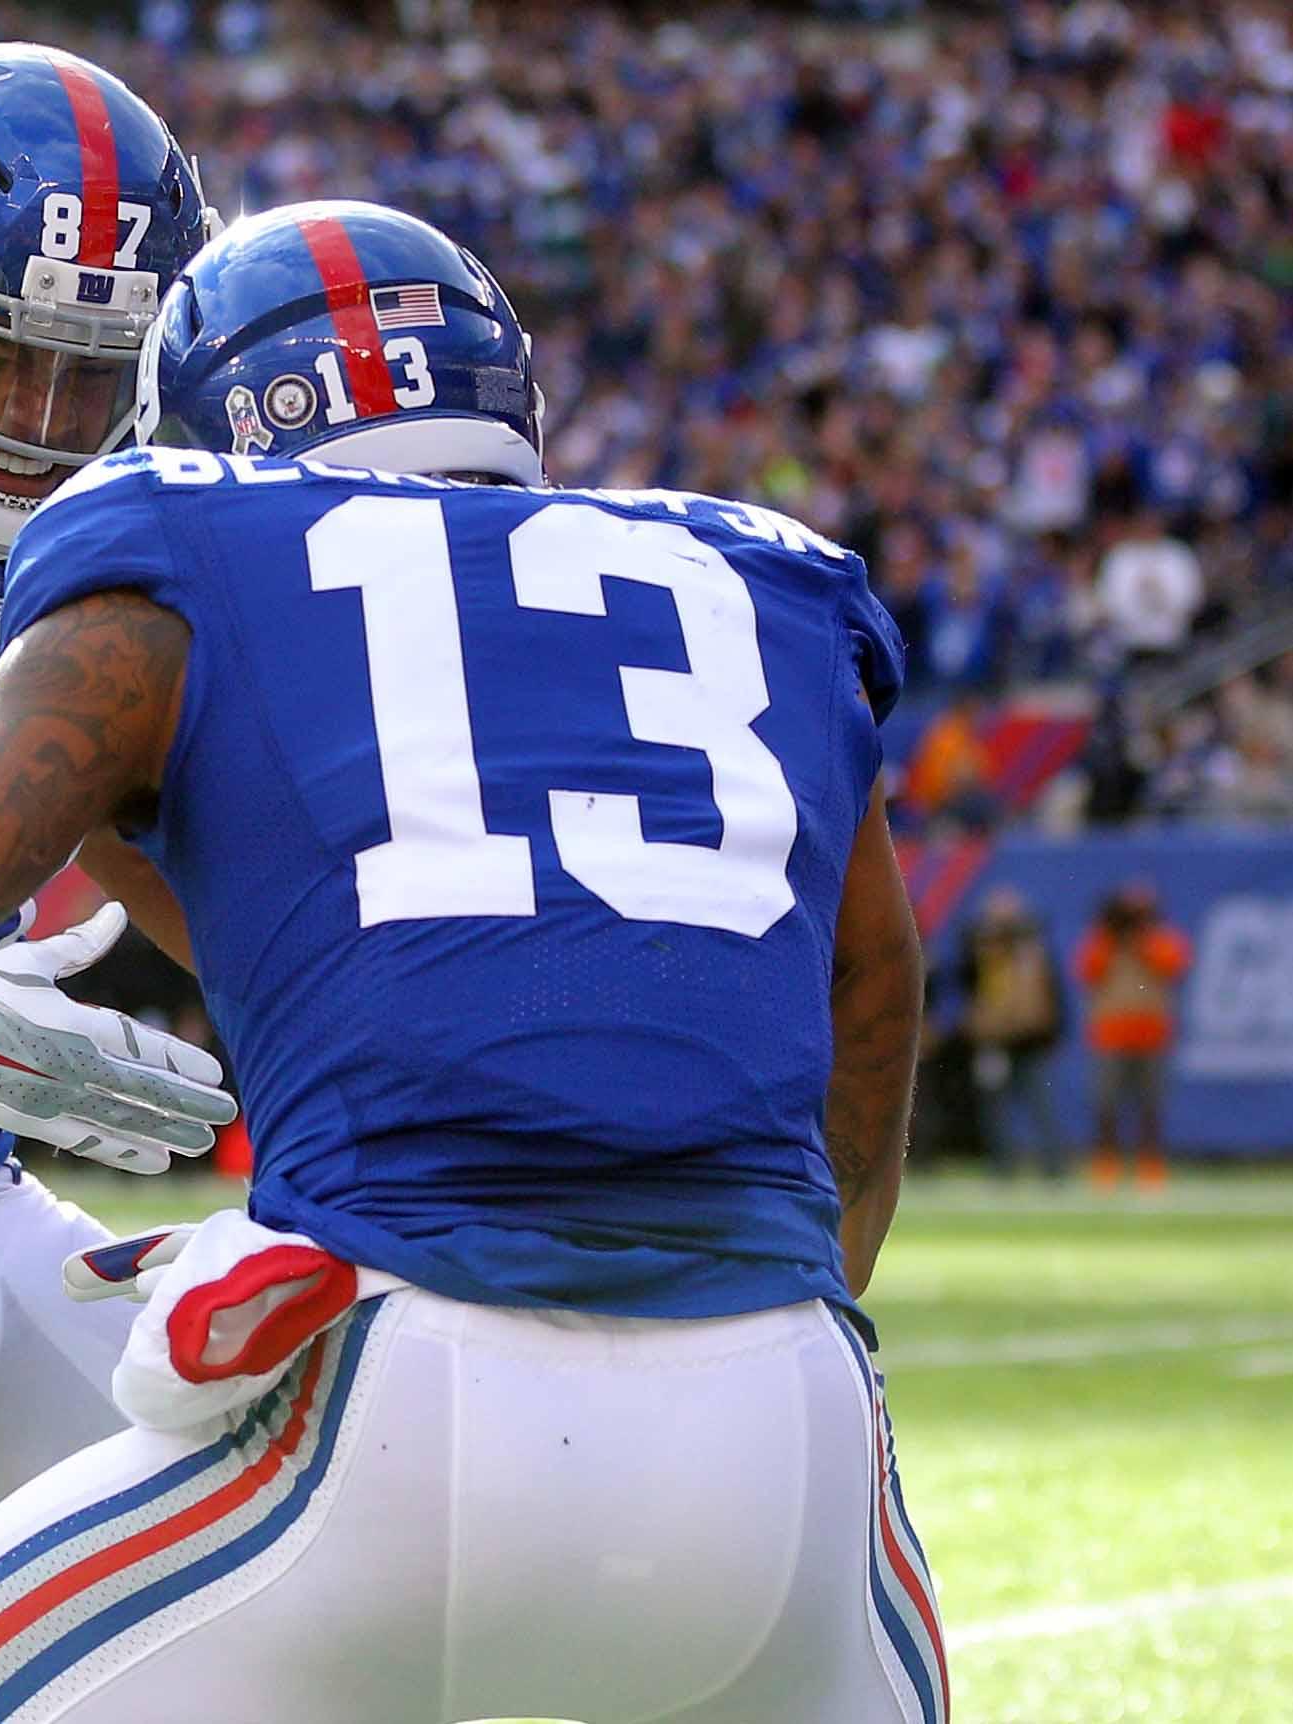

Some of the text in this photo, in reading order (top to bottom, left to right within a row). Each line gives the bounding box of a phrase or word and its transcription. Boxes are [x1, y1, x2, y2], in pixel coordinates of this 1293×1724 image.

[40, 192, 152, 269] 87
[314, 335, 436, 425] 13
[305, 495, 798, 939] 13
